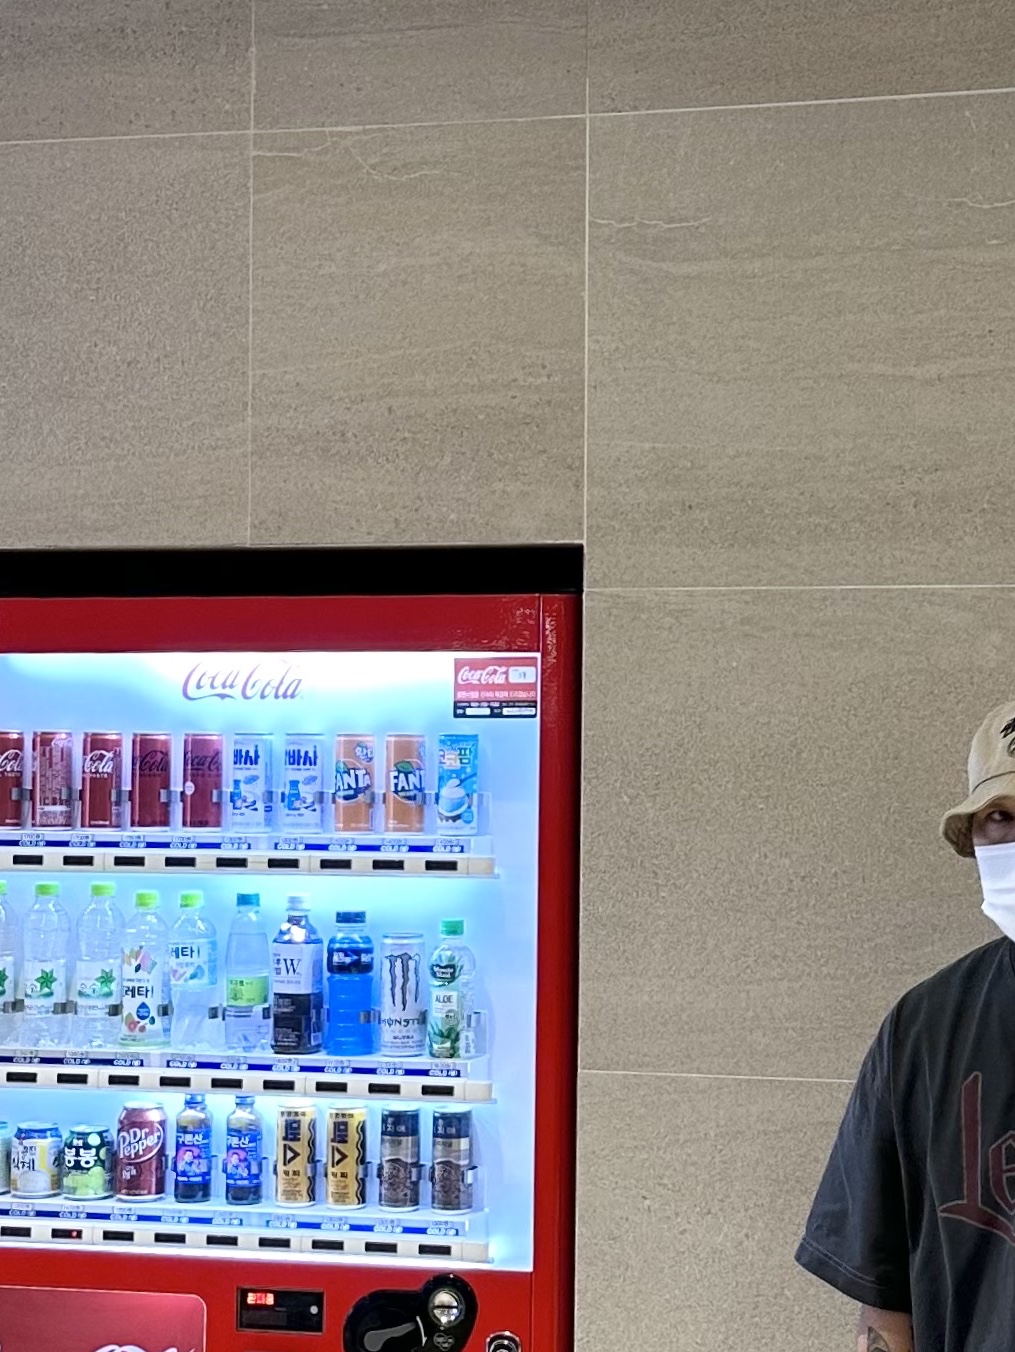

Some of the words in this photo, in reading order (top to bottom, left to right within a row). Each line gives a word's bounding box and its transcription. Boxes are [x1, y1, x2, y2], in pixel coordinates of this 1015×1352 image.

[435, 994, 454, 1003] ALOE
[130, 1127, 149, 1143] Dr
[119, 1131, 162, 1159] Pepper
[64, 1147, 98, 1168] 봉봉
